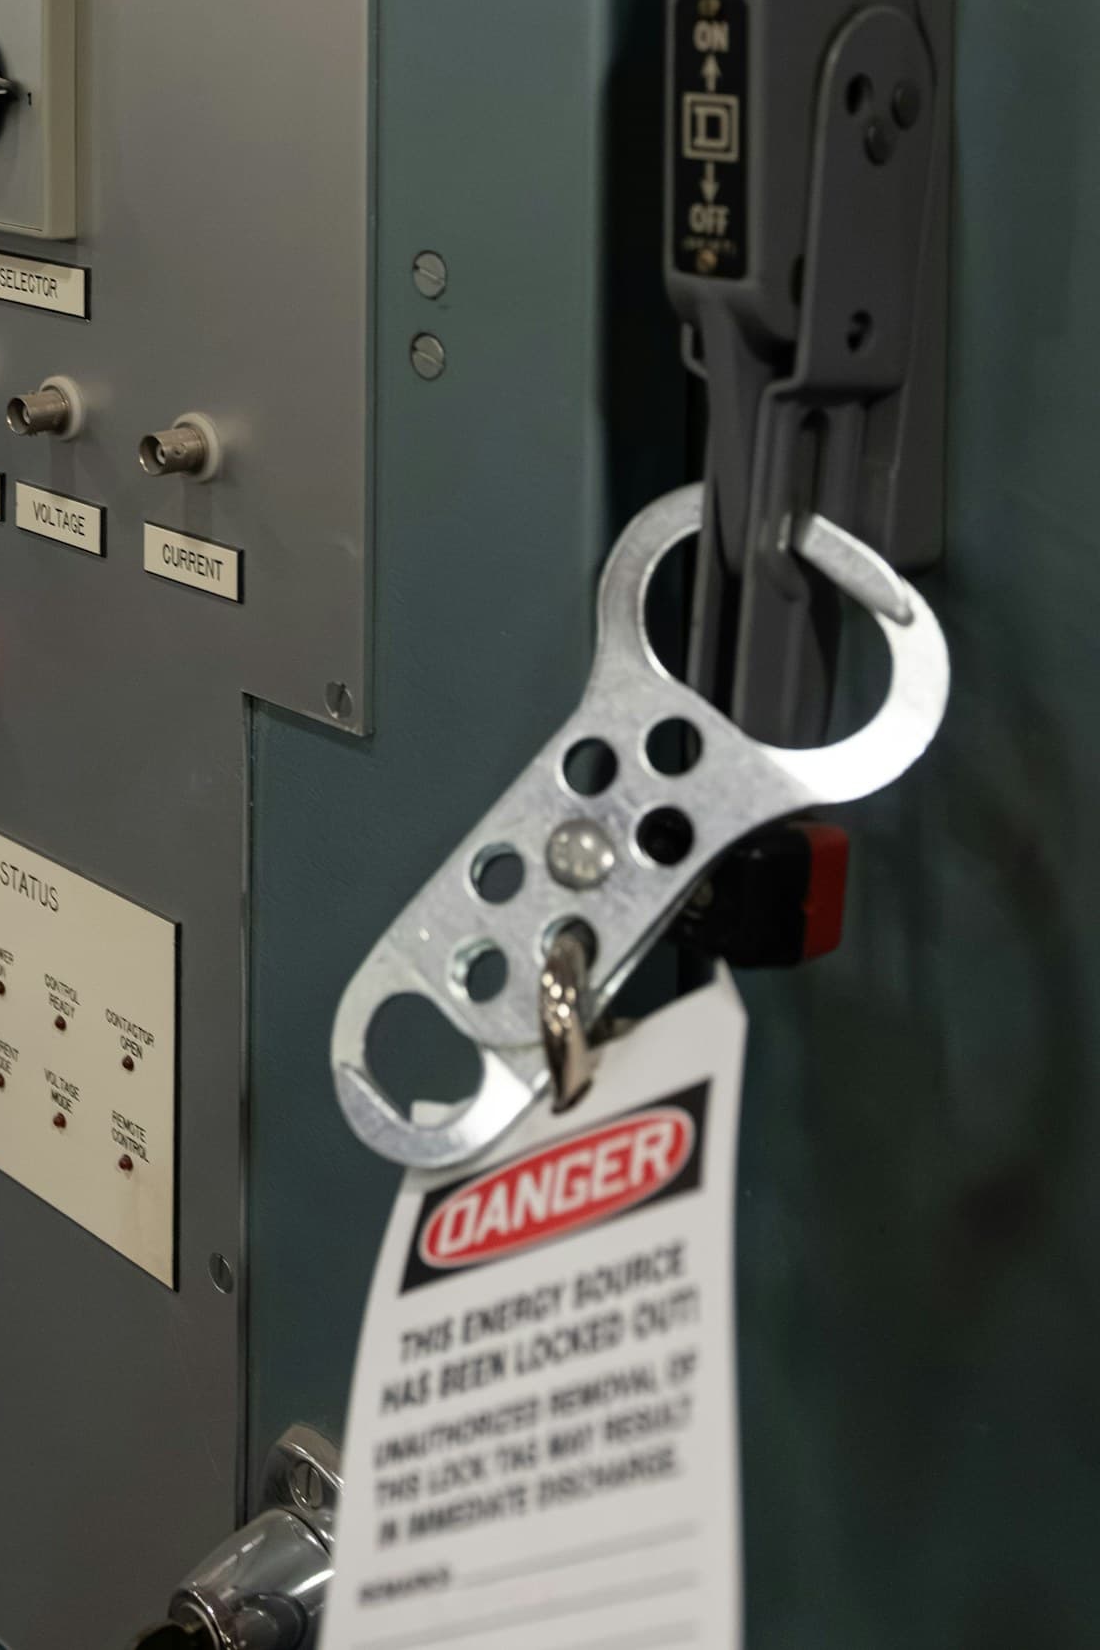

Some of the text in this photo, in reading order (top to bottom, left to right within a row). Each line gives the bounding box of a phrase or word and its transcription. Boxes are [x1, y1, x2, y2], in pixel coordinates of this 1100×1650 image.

[693, 21, 729, 52] ON
[27, 92, 32, 106] 1
[688, 203, 729, 235] OFF
[0, 266, 58, 299] SELECTOR
[33, 501, 86, 536] VOLTAGE
[162, 543, 224, 581] CURRENT
[0, 861, 59, 912] STATUS
[44, 973, 82, 1006] CONTROL
[105, 1008, 155, 1047] CONTACTOR
[120, 1035, 143, 1059] OPEN
[44, 1068, 81, 1102] VOLTAGE
[51, 1088, 73, 1114] MODE
[112, 1109, 148, 1144] REMOTE
[111, 1127, 150, 1163] CONTROL
[436, 1119, 675, 1257] DANGER
[400, 1238, 686, 1363] THIS ENERGY SOURCE
[380, 1368, 431, 1417] HAS
[439, 1344, 506, 1399] BEEN
[513, 1308, 626, 1377] LOCKED
[373, 1396, 539, 1471] UNAUTHORIZED
[549, 1362, 658, 1418] REMOVAL
[374, 1474, 420, 1509] THIS
[427, 1456, 485, 1496] LOCK
[601, 1390, 693, 1444] RESULT
[407, 1482, 528, 1540] IMMEDIATE
